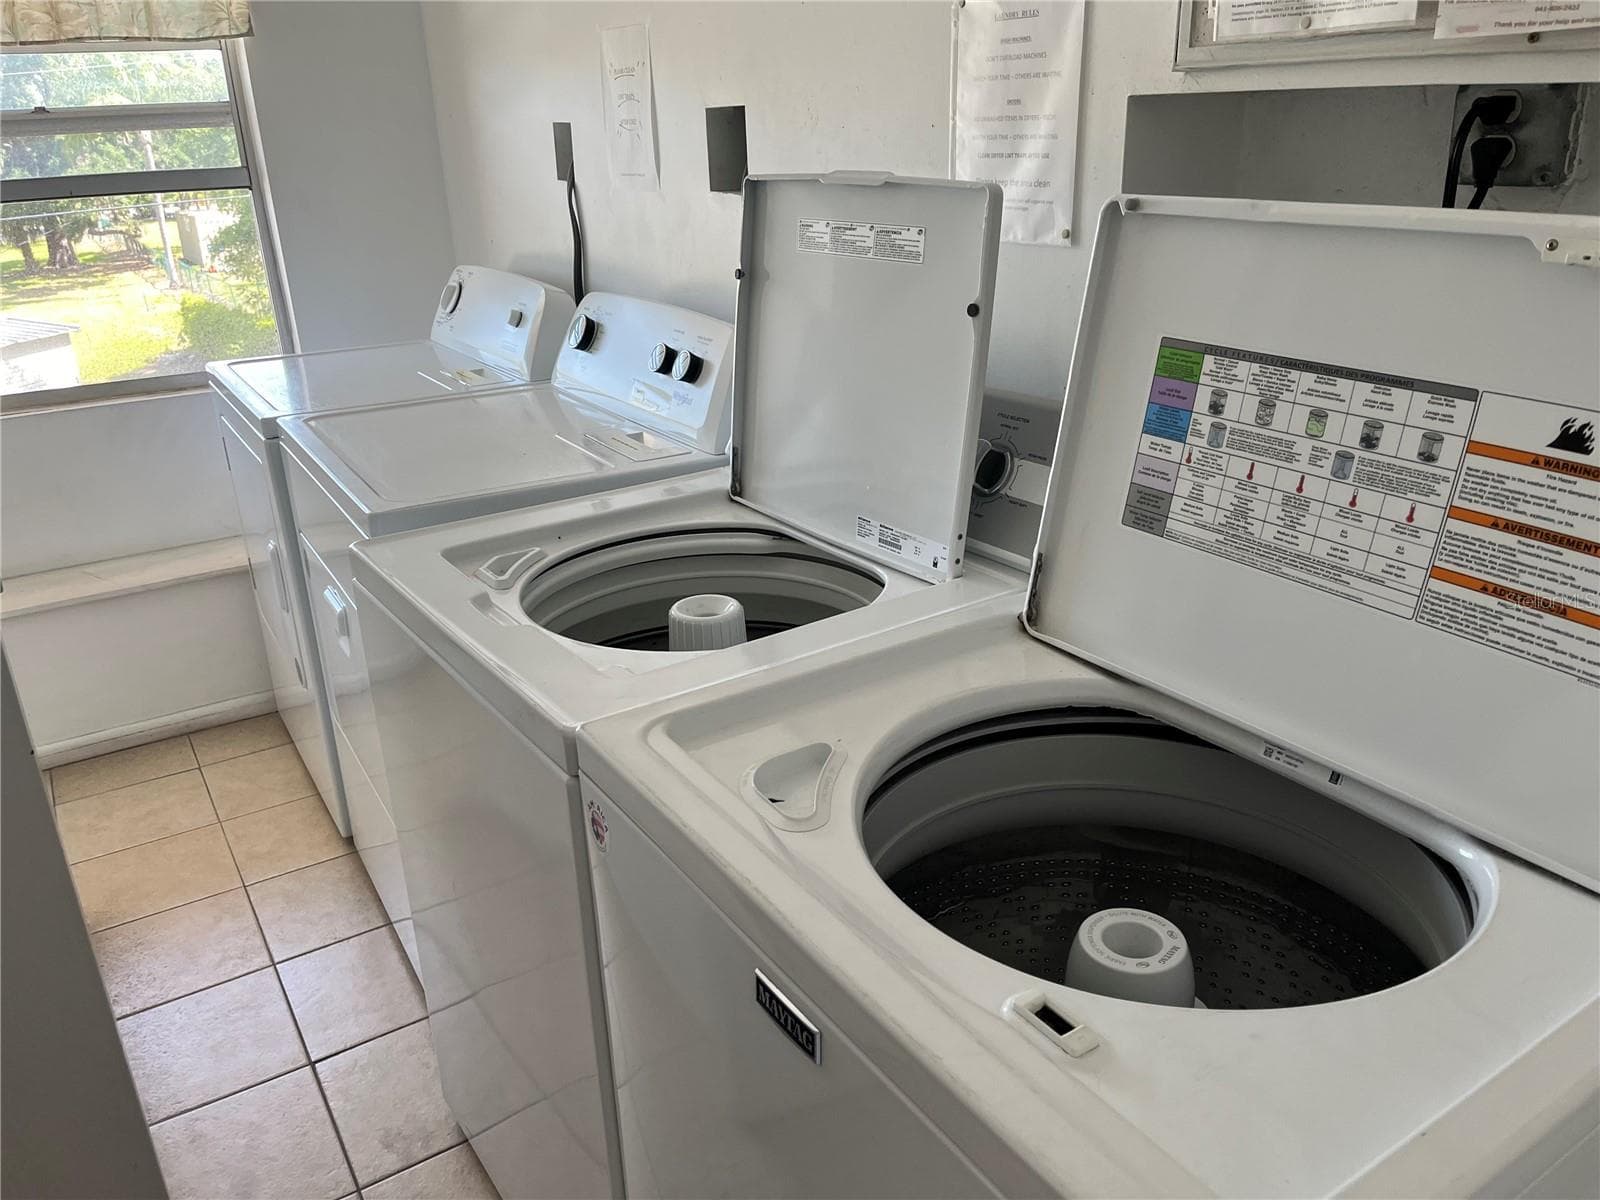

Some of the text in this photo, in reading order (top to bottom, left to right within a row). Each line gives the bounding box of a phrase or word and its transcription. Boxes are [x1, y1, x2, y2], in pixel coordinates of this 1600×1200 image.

[1544, 459, 1600, 478] WARNING
[1558, 477, 1577, 485] Hazard
[1503, 523, 1599, 553] AVERTISSEMENT
[758, 983, 812, 1053] MAYTAG
